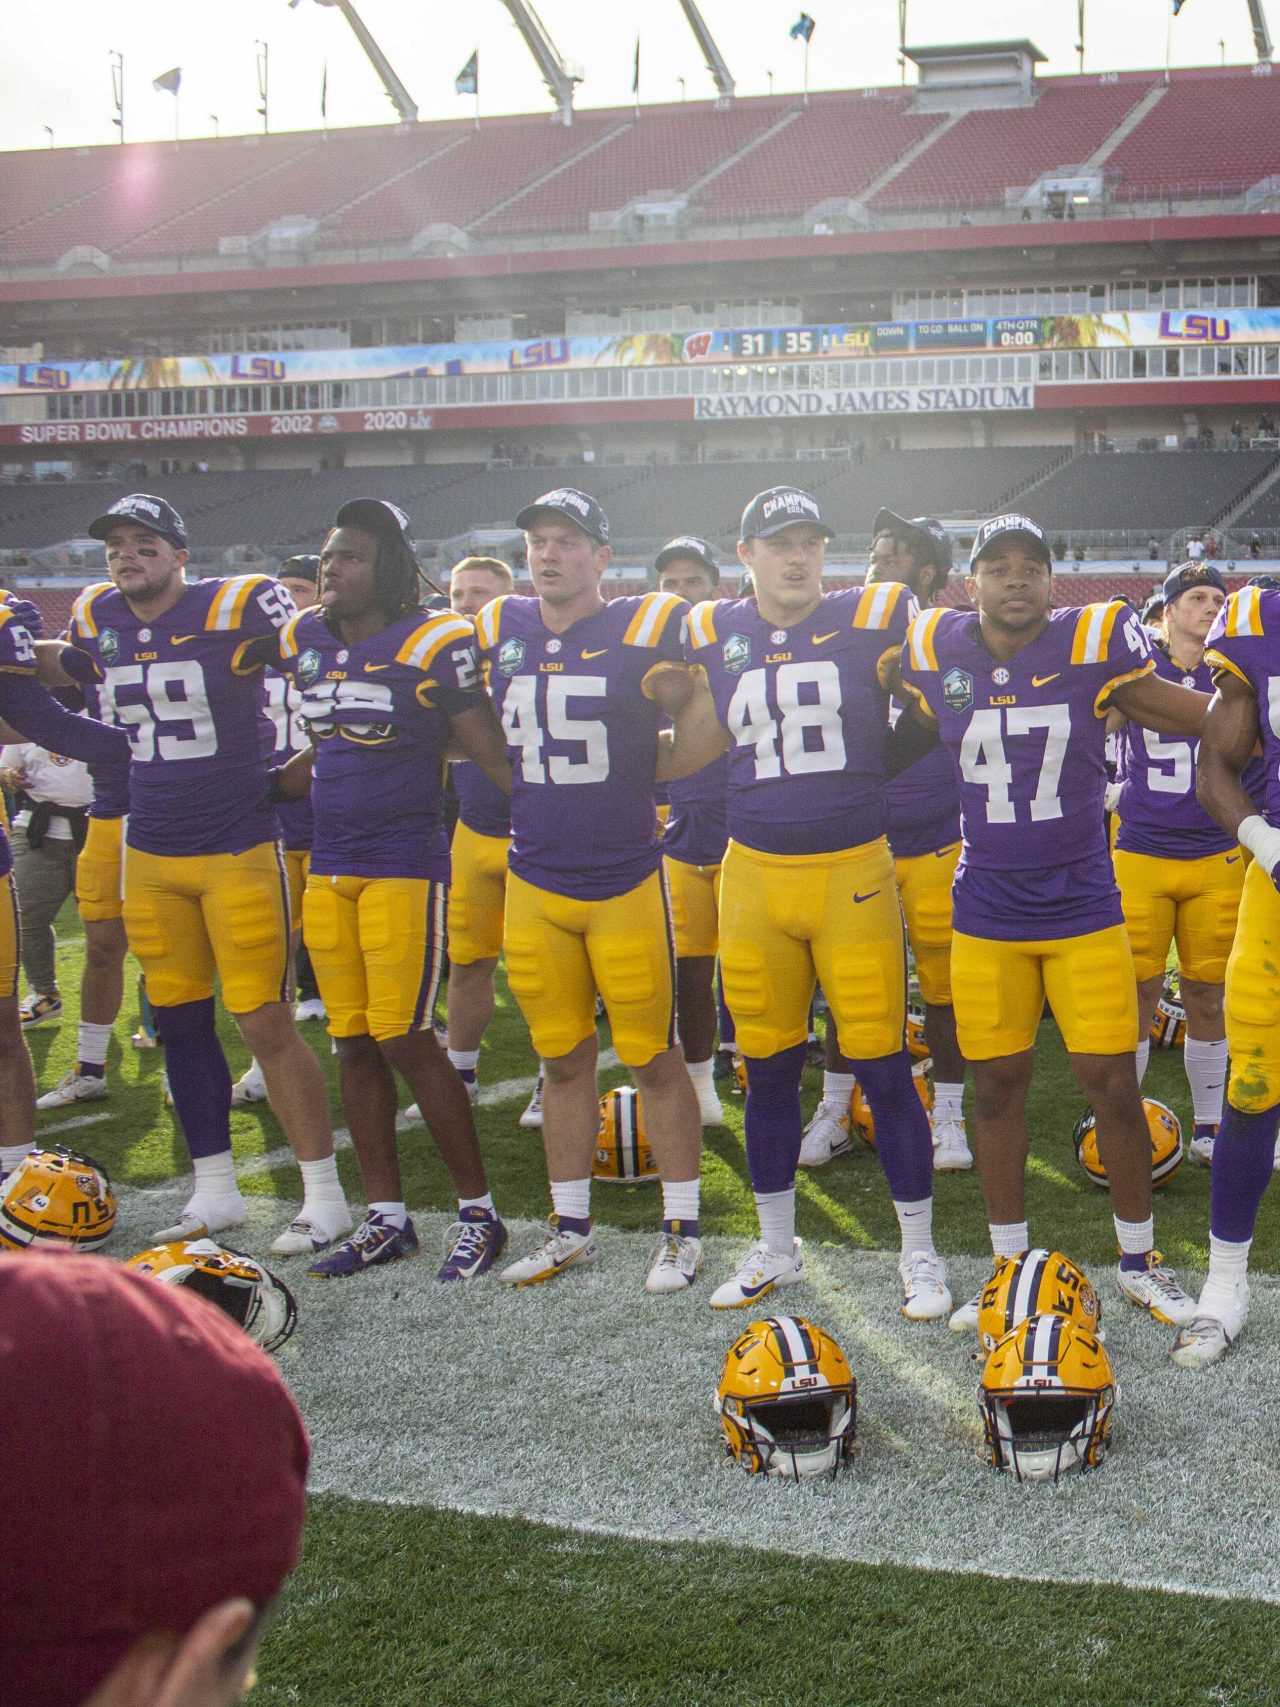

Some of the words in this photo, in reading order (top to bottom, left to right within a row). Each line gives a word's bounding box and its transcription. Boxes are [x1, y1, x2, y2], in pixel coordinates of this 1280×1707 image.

[876, 327, 905, 337] DOWN
[918, 325, 930, 335] TO
[948, 324, 968, 334] BALL
[970, 323, 984, 333] ON
[996, 321, 1015, 330] 4TH
[1159, 311, 1230, 341] LSU
[740, 333, 765, 355] 31
[785, 332, 812, 352] 35
[830, 332, 870, 349] LSU
[1000, 331, 1034, 346] 0:00
[508, 338, 570, 369] LSU
[18, 363, 71, 390] LSU
[230, 355, 287, 381] LSU
[698, 393, 823, 418] RAYMOND
[826, 390, 910, 413] JAMES
[916, 386, 1031, 412] STADIUM
[21, 425, 80, 443] SUPER
[85, 424, 137, 440] BOWL
[140, 419, 248, 439] CHAMPIONS
[271, 416, 312, 434] 2002
[364, 412, 407, 430] 2020
[539, 662, 565, 672] LSU
[765, 652, 793, 664] LSU
[989, 694, 1017, 705] LSU
[97, 660, 219, 762] 59
[728, 661, 848, 779] 48
[502, 675, 610, 785] 45
[959, 703, 1072, 823] 47
[1142, 727, 1200, 794] 5
[791, 1377, 818, 1389] LSU
[1026, 1379, 1052, 1387] LSU
